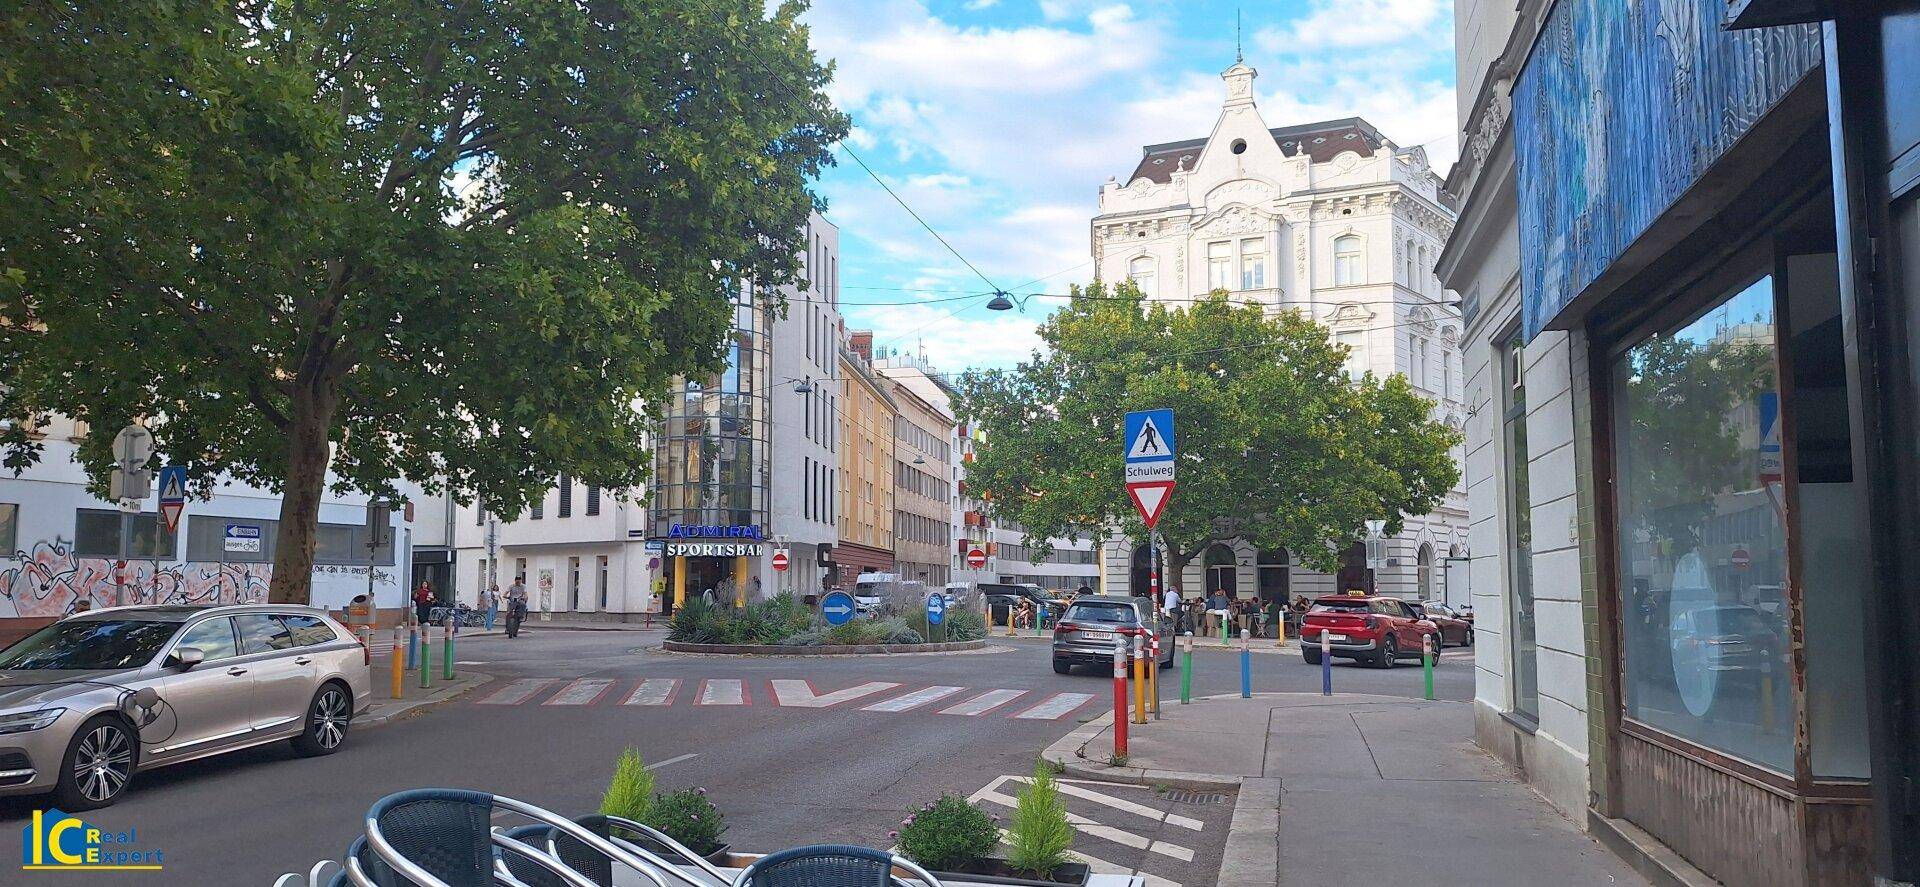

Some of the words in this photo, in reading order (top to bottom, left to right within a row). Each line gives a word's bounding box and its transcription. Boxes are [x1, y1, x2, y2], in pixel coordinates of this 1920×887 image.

[1127, 466, 1173, 477] Schulweg
[668, 523, 763, 540] ADMIRAL
[667, 544, 763, 556] SPORTSBAR
